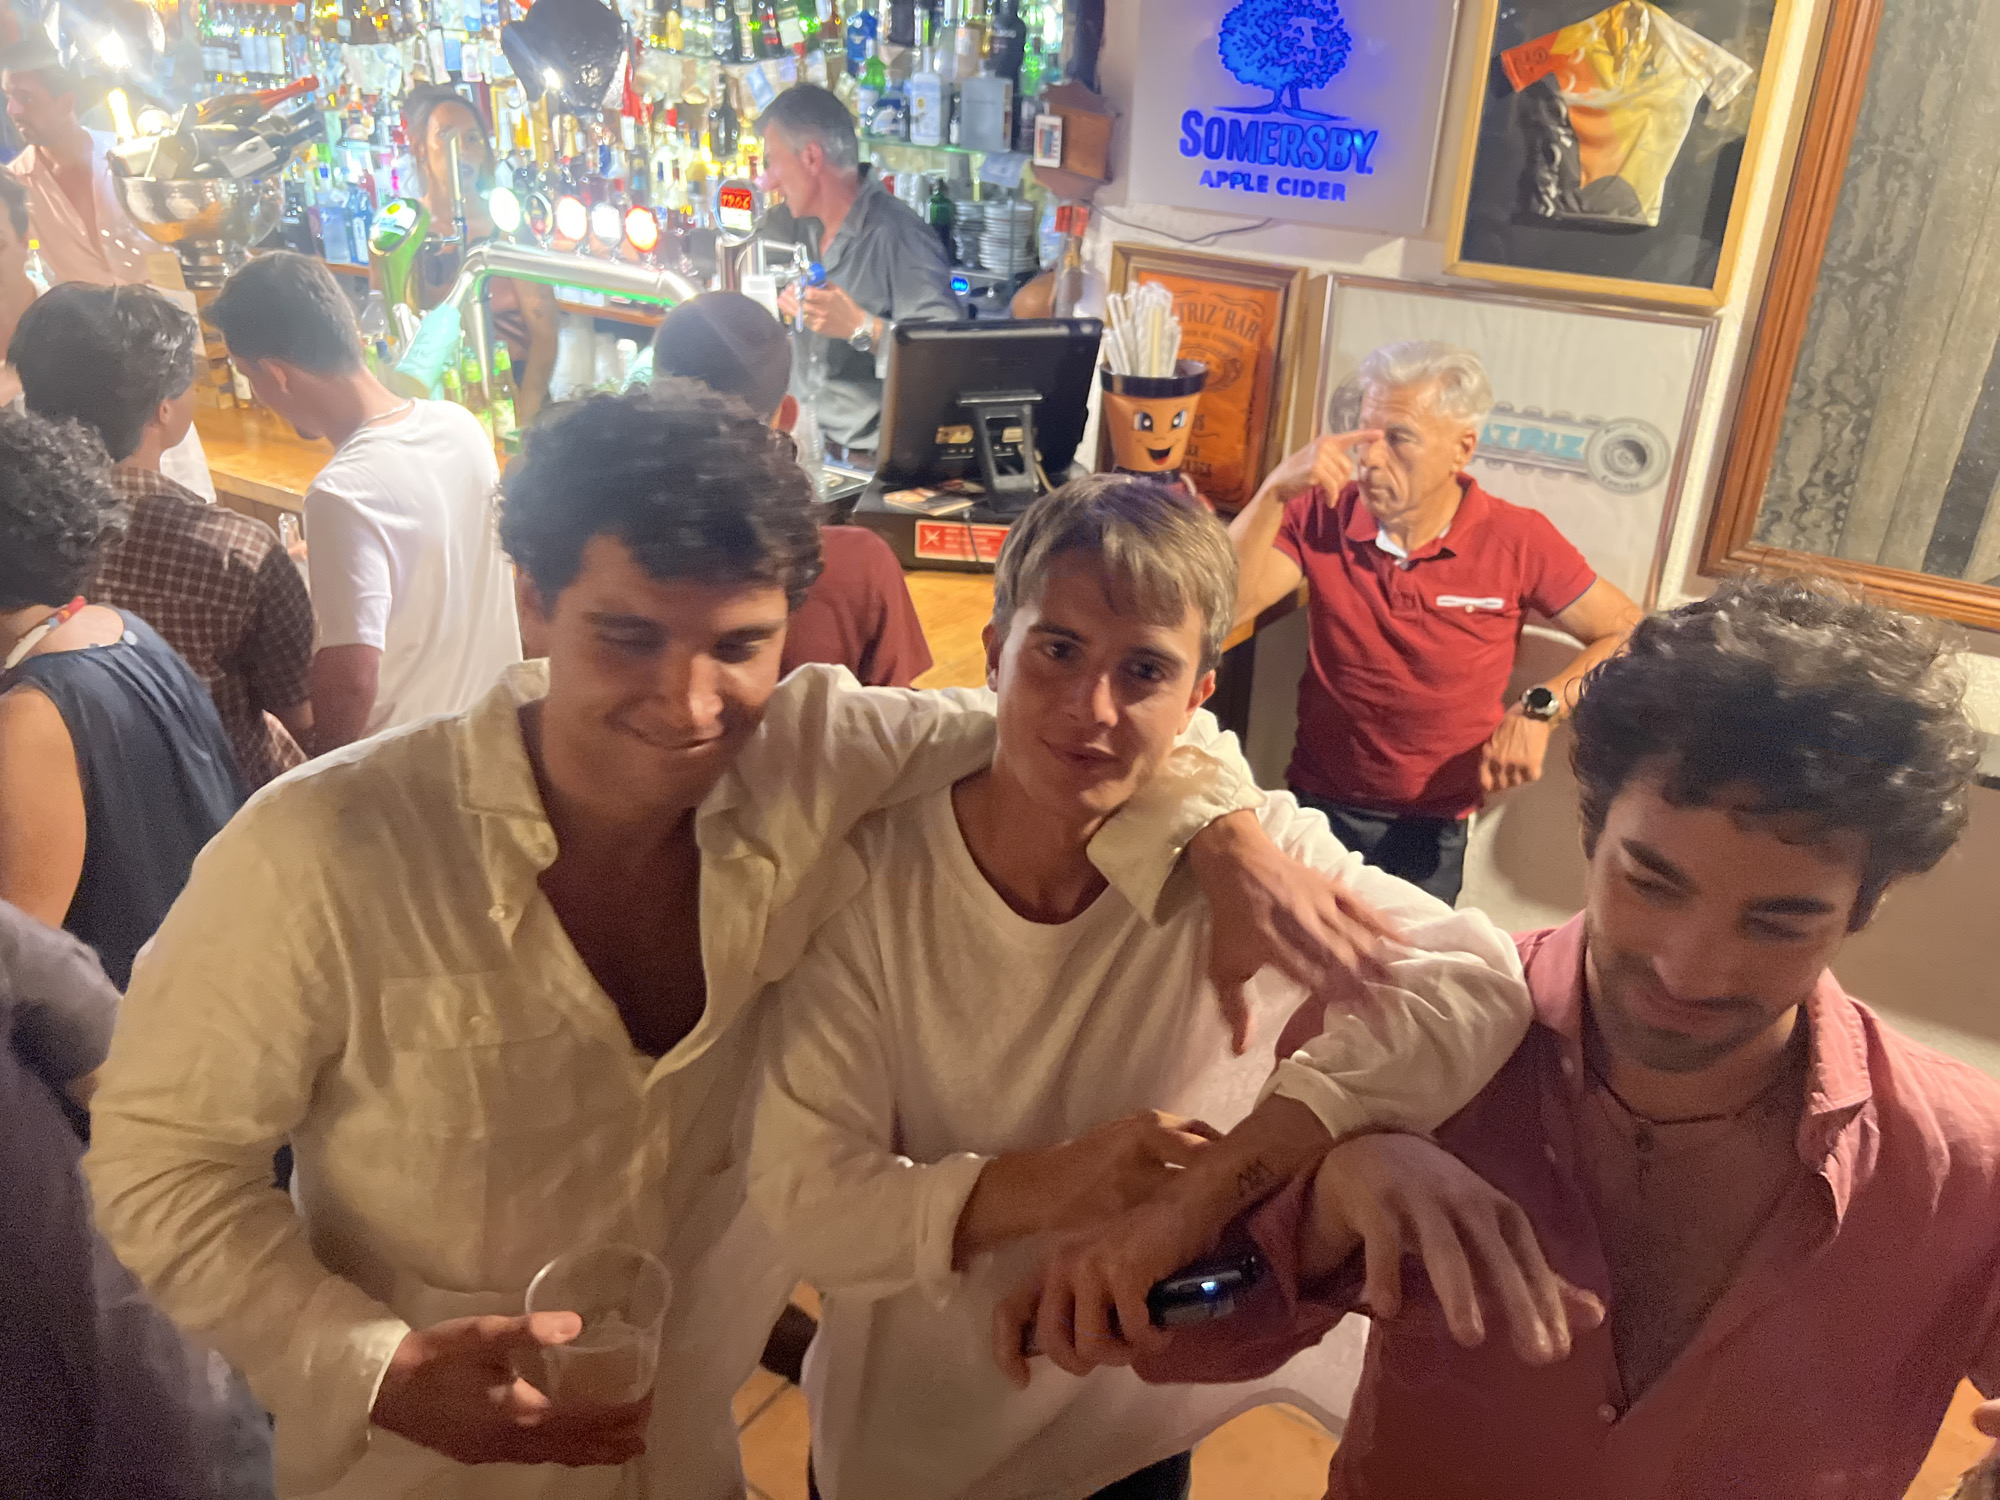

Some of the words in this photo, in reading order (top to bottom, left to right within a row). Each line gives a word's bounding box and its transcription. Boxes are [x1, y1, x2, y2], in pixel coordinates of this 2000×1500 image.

[1199, 169, 1269, 194] APPLE
[1275, 177, 1346, 202] CIDER
[722, 194, 752, 211] 1906
